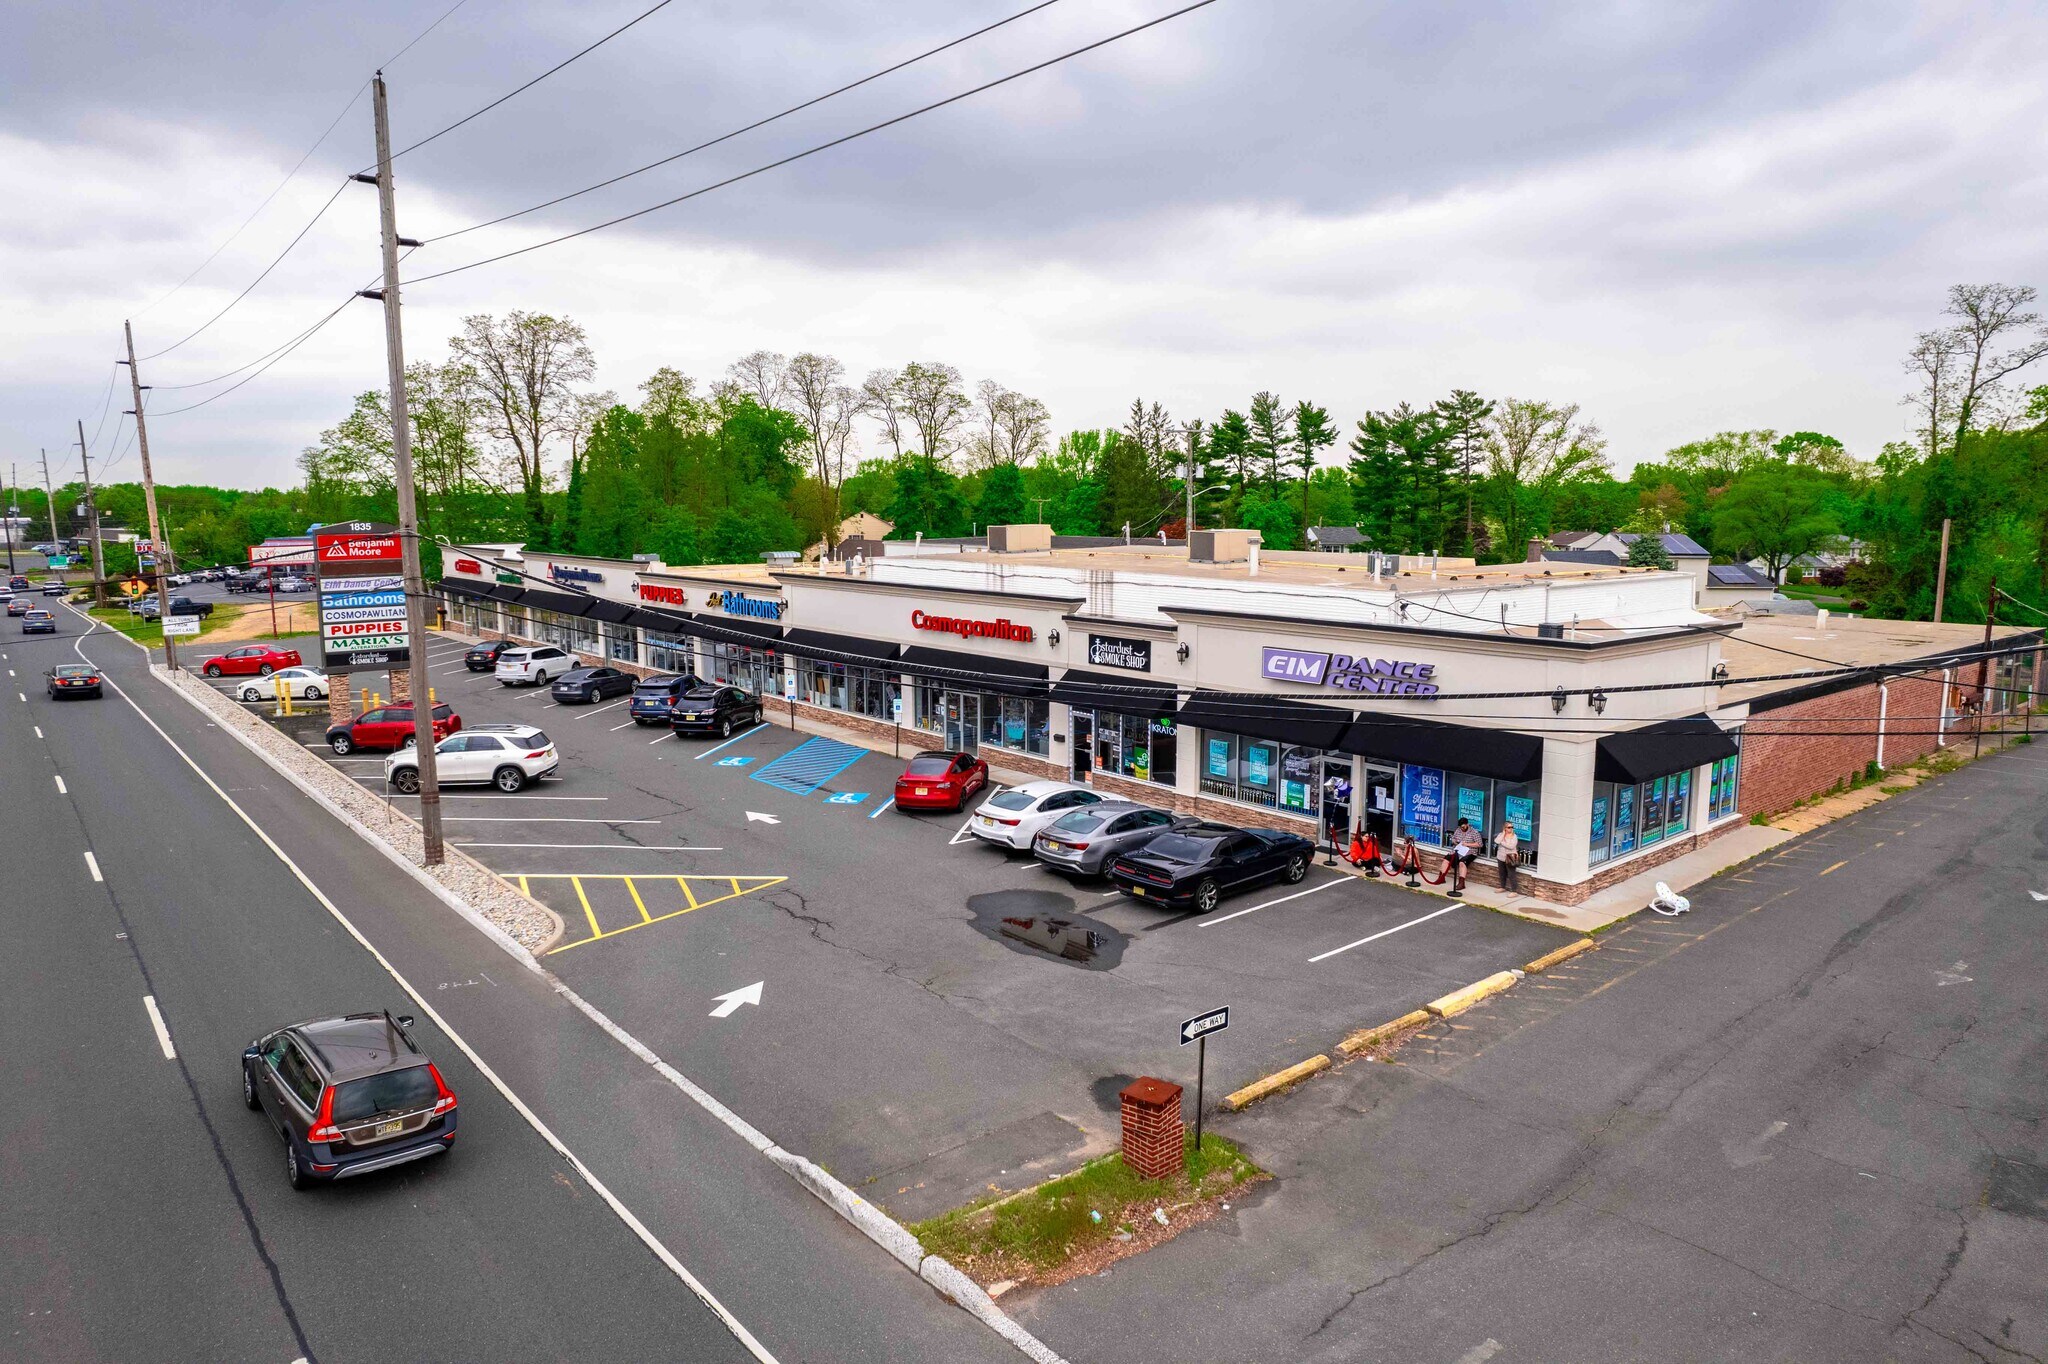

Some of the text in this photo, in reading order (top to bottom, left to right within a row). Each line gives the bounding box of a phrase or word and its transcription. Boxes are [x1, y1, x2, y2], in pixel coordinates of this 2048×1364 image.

[349, 522, 372, 531] 1835
[348, 538, 395, 549] Benjamin
[349, 547, 382, 556] Moore
[344, 578, 372, 588] Dance
[322, 594, 406, 608] Bathrooms
[639, 585, 684, 605] PUPPIES
[723, 589, 780, 620] Bathrooms
[325, 608, 406, 621] COSMOPAWLITAN
[331, 621, 403, 636] PUPPIES
[911, 609, 1034, 643] Cosmopawlitan
[331, 635, 404, 649] MARIA'S
[1100, 641, 1133, 656] stardust
[1100, 651, 1146, 669] SMOKE SHOP
[1267, 655, 1322, 678] EIM
[1331, 654, 1436, 681] DANCE
[1326, 672, 1440, 699] CENTER
[1421, 774, 1439, 787] BTS
[1414, 812, 1438, 823] WINNER
[1194, 1014, 1224, 1032] ONE WAY
